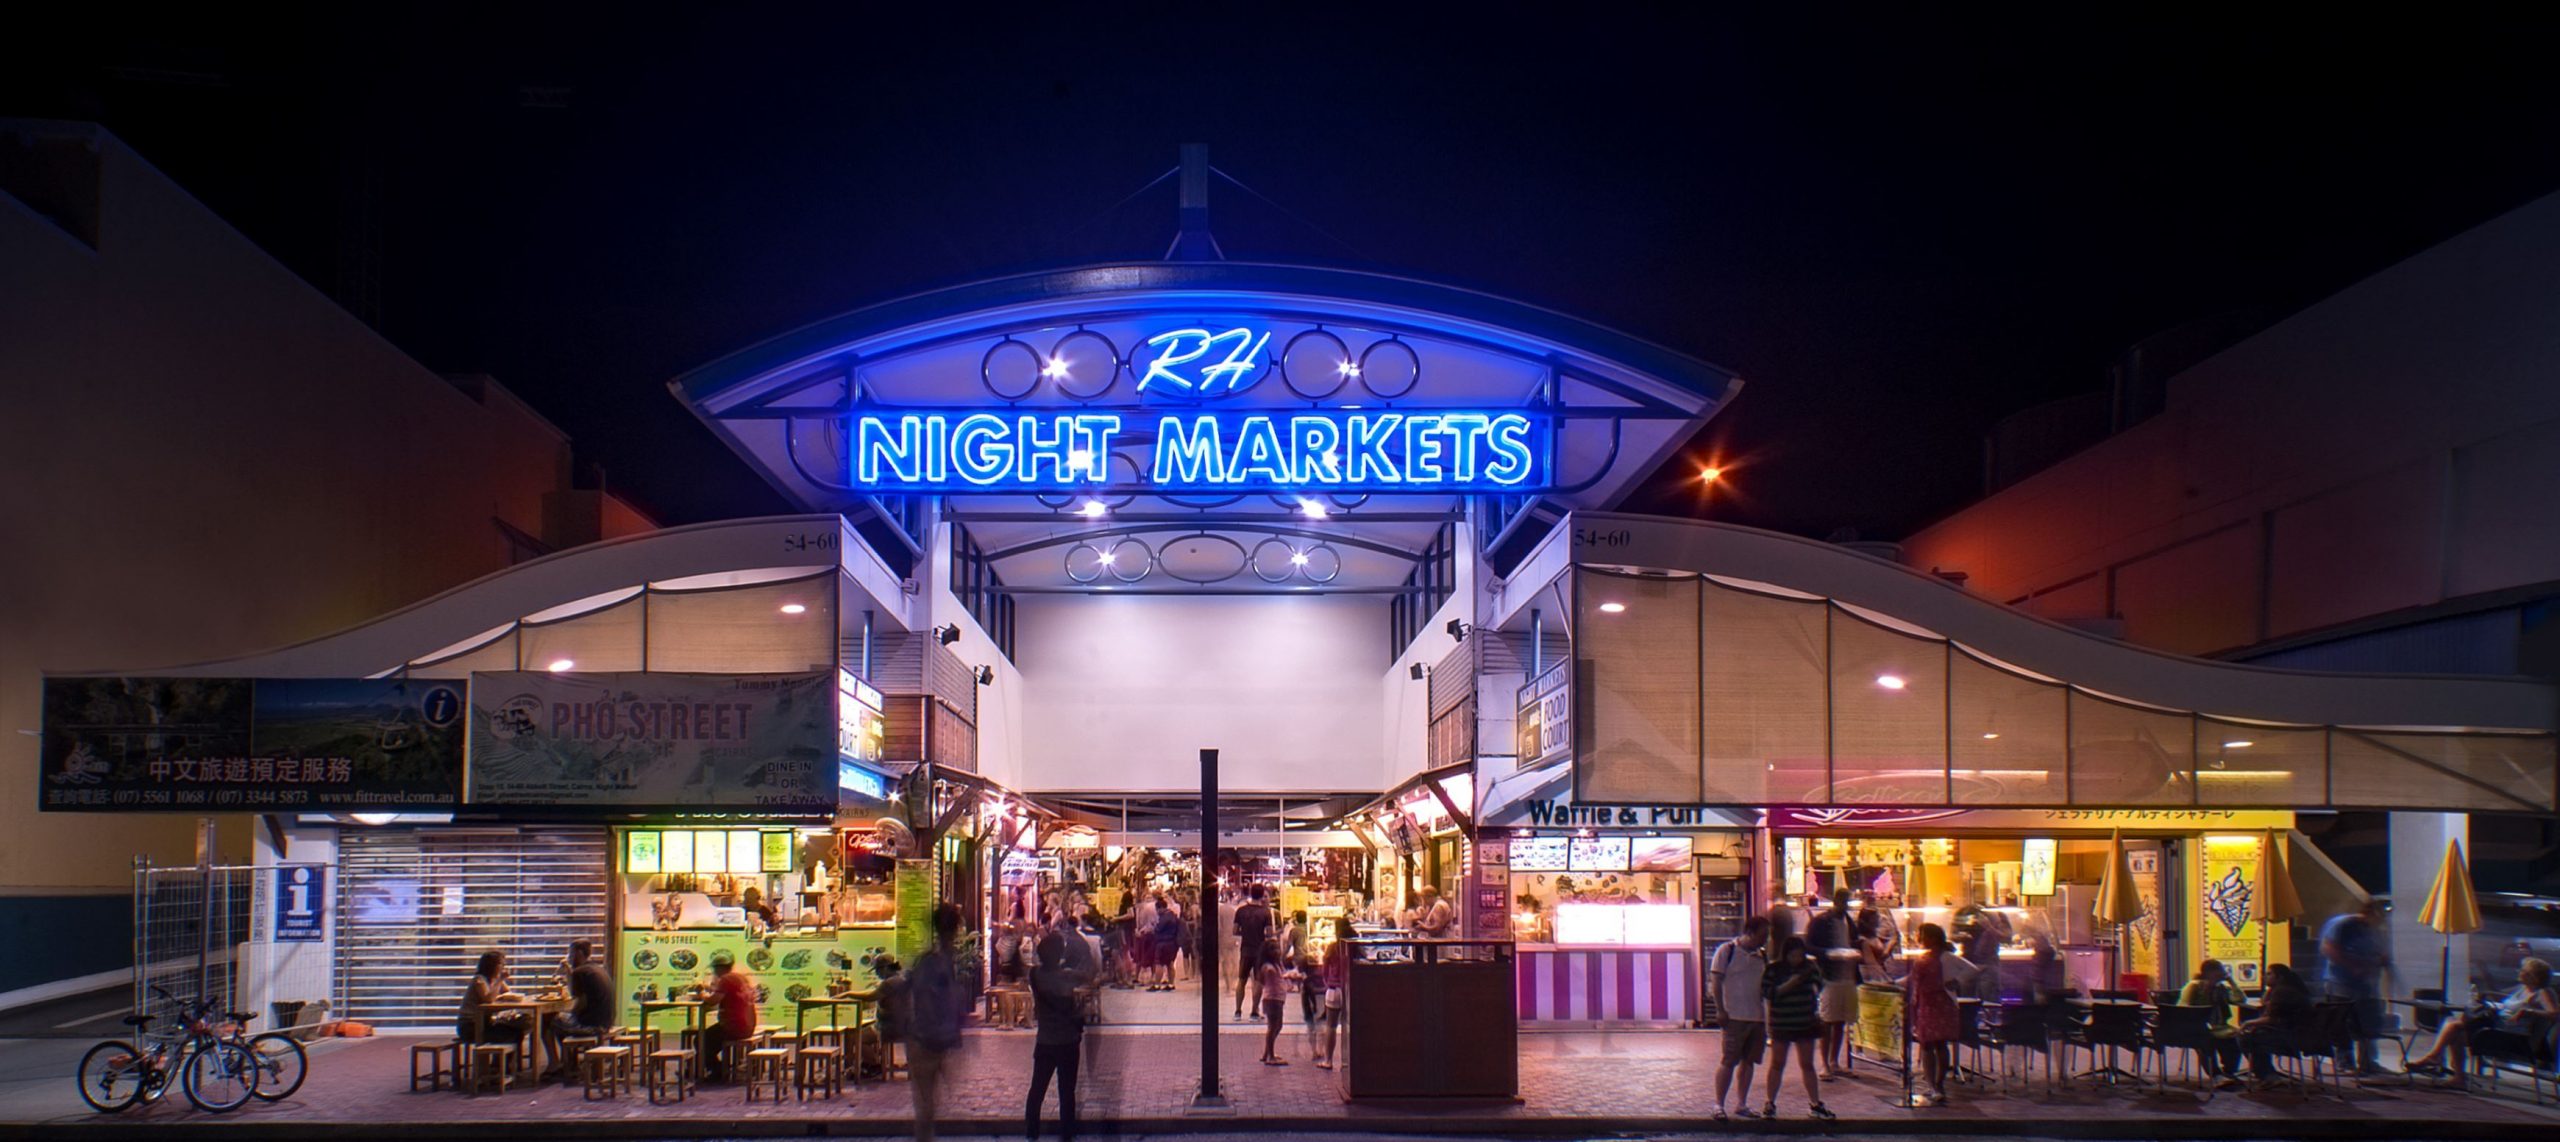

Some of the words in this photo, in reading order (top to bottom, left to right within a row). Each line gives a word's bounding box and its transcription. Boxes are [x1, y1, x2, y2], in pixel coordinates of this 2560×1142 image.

[1137, 327, 1271, 394] RH
[858, 414, 1121, 485] NIGHT
[1153, 414, 1533, 485] MARKETS
[785, 532, 839, 552] 54-60
[1574, 528, 1631, 547] 54-60
[1543, 693, 1566, 724] FOOD
[624, 702, 753, 740] STREET
[1542, 719, 1570, 751] COURT
[149, 756, 352, 783] 中文旅遊預定服務
[767, 762, 796, 772] DINE
[799, 762, 812, 772] IN
[780, 778, 799, 789] OR
[112, 790, 139, 804] (07)
[142, 790, 170, 804] 5561
[175, 790, 204, 804] 1068
[215, 790, 242, 804] (07)
[244, 790, 275, 804] 3344
[277, 790, 309, 804] 5873
[319, 789, 454, 804] www.fittravel.com.au
[755, 795, 786, 805] TAKE
[790, 795, 825, 805] AWAY
[671, 935, 698, 945] STREET
